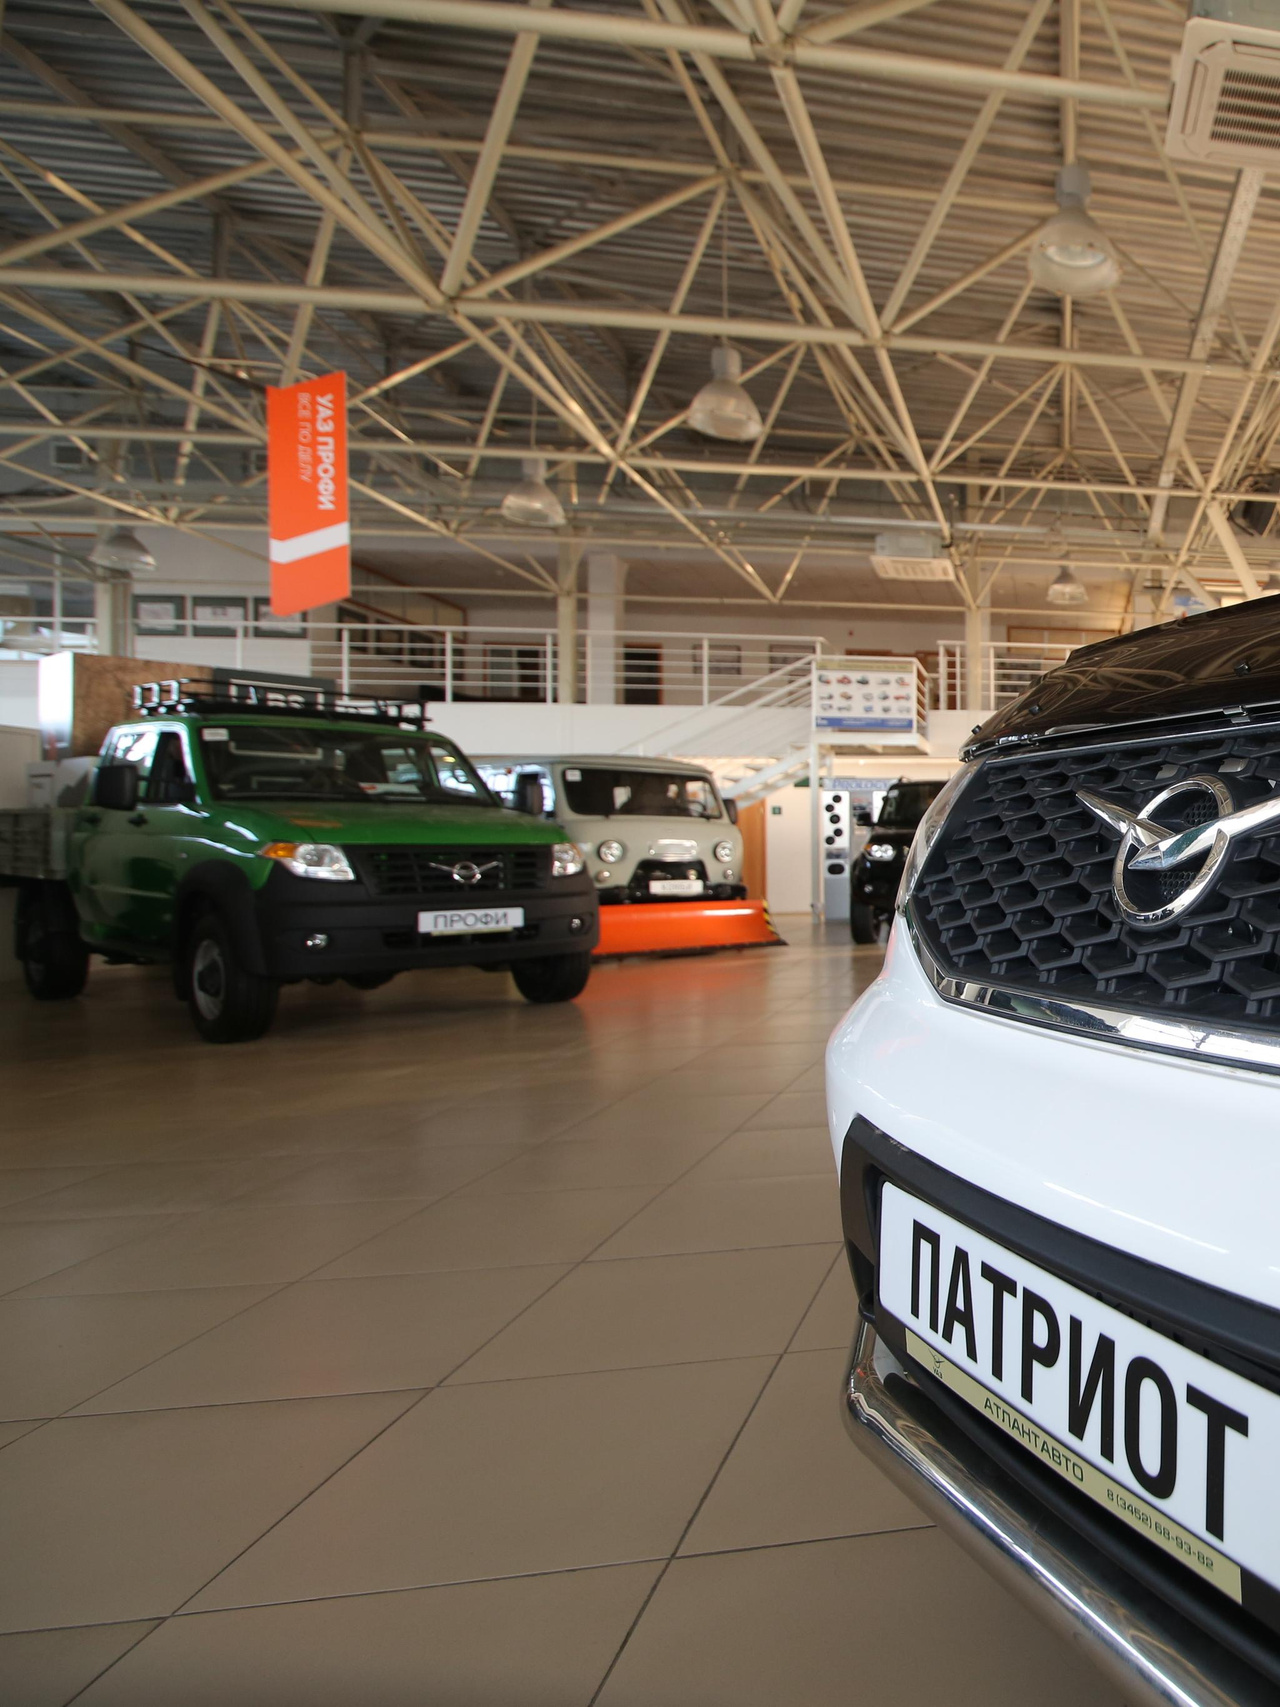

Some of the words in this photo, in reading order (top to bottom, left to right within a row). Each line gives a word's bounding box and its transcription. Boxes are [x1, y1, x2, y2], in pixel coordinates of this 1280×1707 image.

[298, 423, 312, 443] ПО
[316, 393, 335, 432] УАЗ
[316, 436, 336, 511] ПРОФИ
[433, 911, 509, 929] ПРОФИ
[910, 1219, 1249, 1542] ПАТРИОТ
[984, 1397, 1084, 1482] АТЛАНТАВТО
[1106, 1488, 1114, 1502] 8
[1154, 1521, 1214, 1572] 68-93-82
